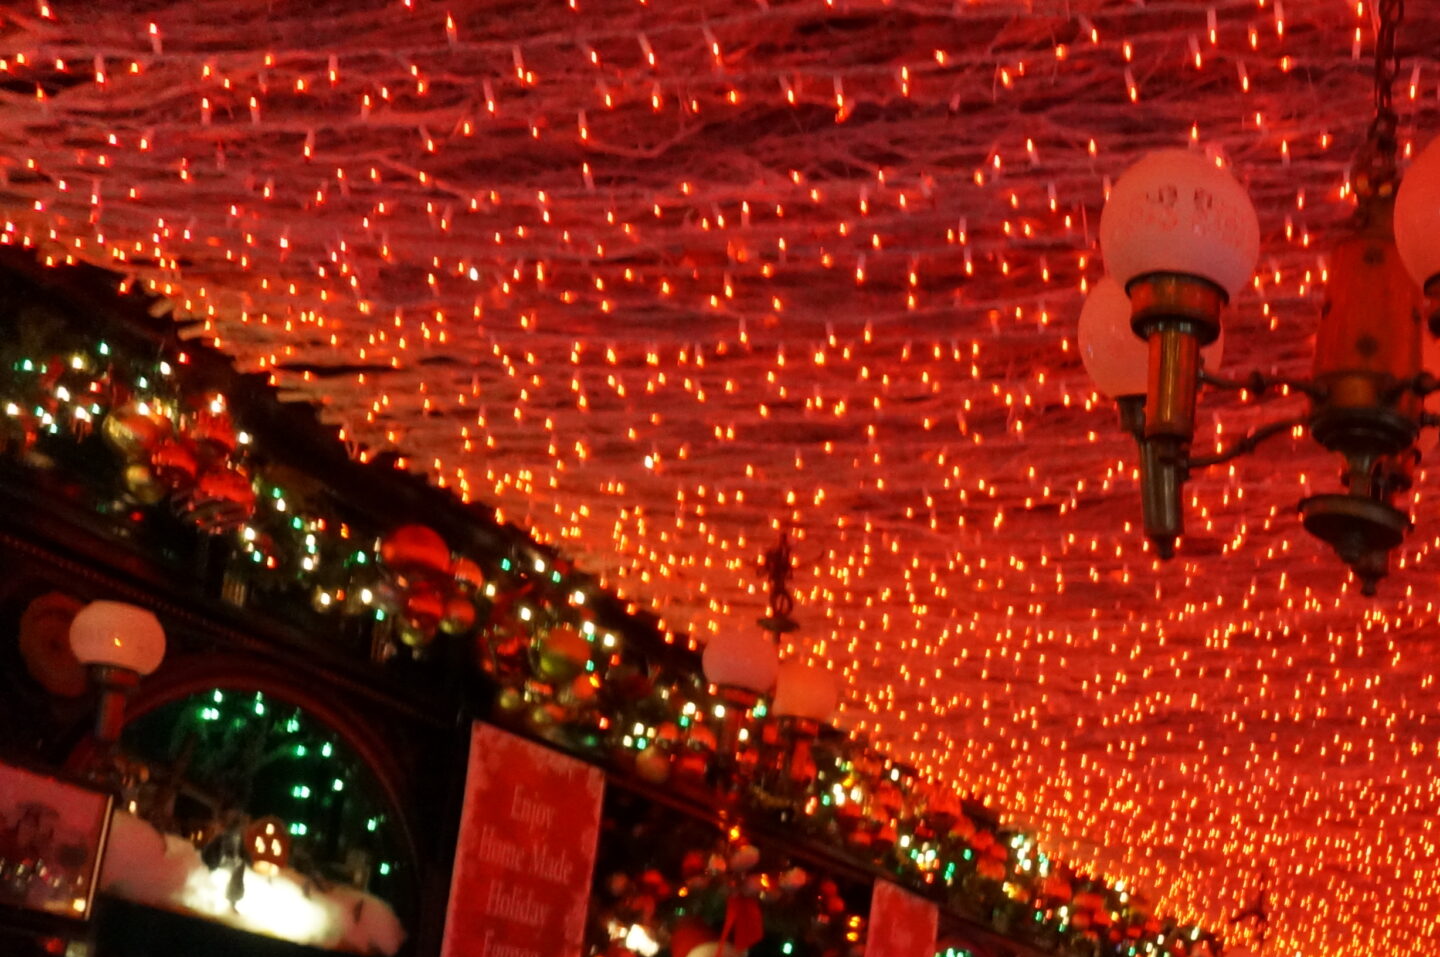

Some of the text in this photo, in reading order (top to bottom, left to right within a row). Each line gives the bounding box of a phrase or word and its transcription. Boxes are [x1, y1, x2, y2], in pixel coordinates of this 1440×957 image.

[511, 784, 556, 840] Enjoy
[479, 824, 574, 885] Home Made
[486, 878, 551, 940] Holiday
